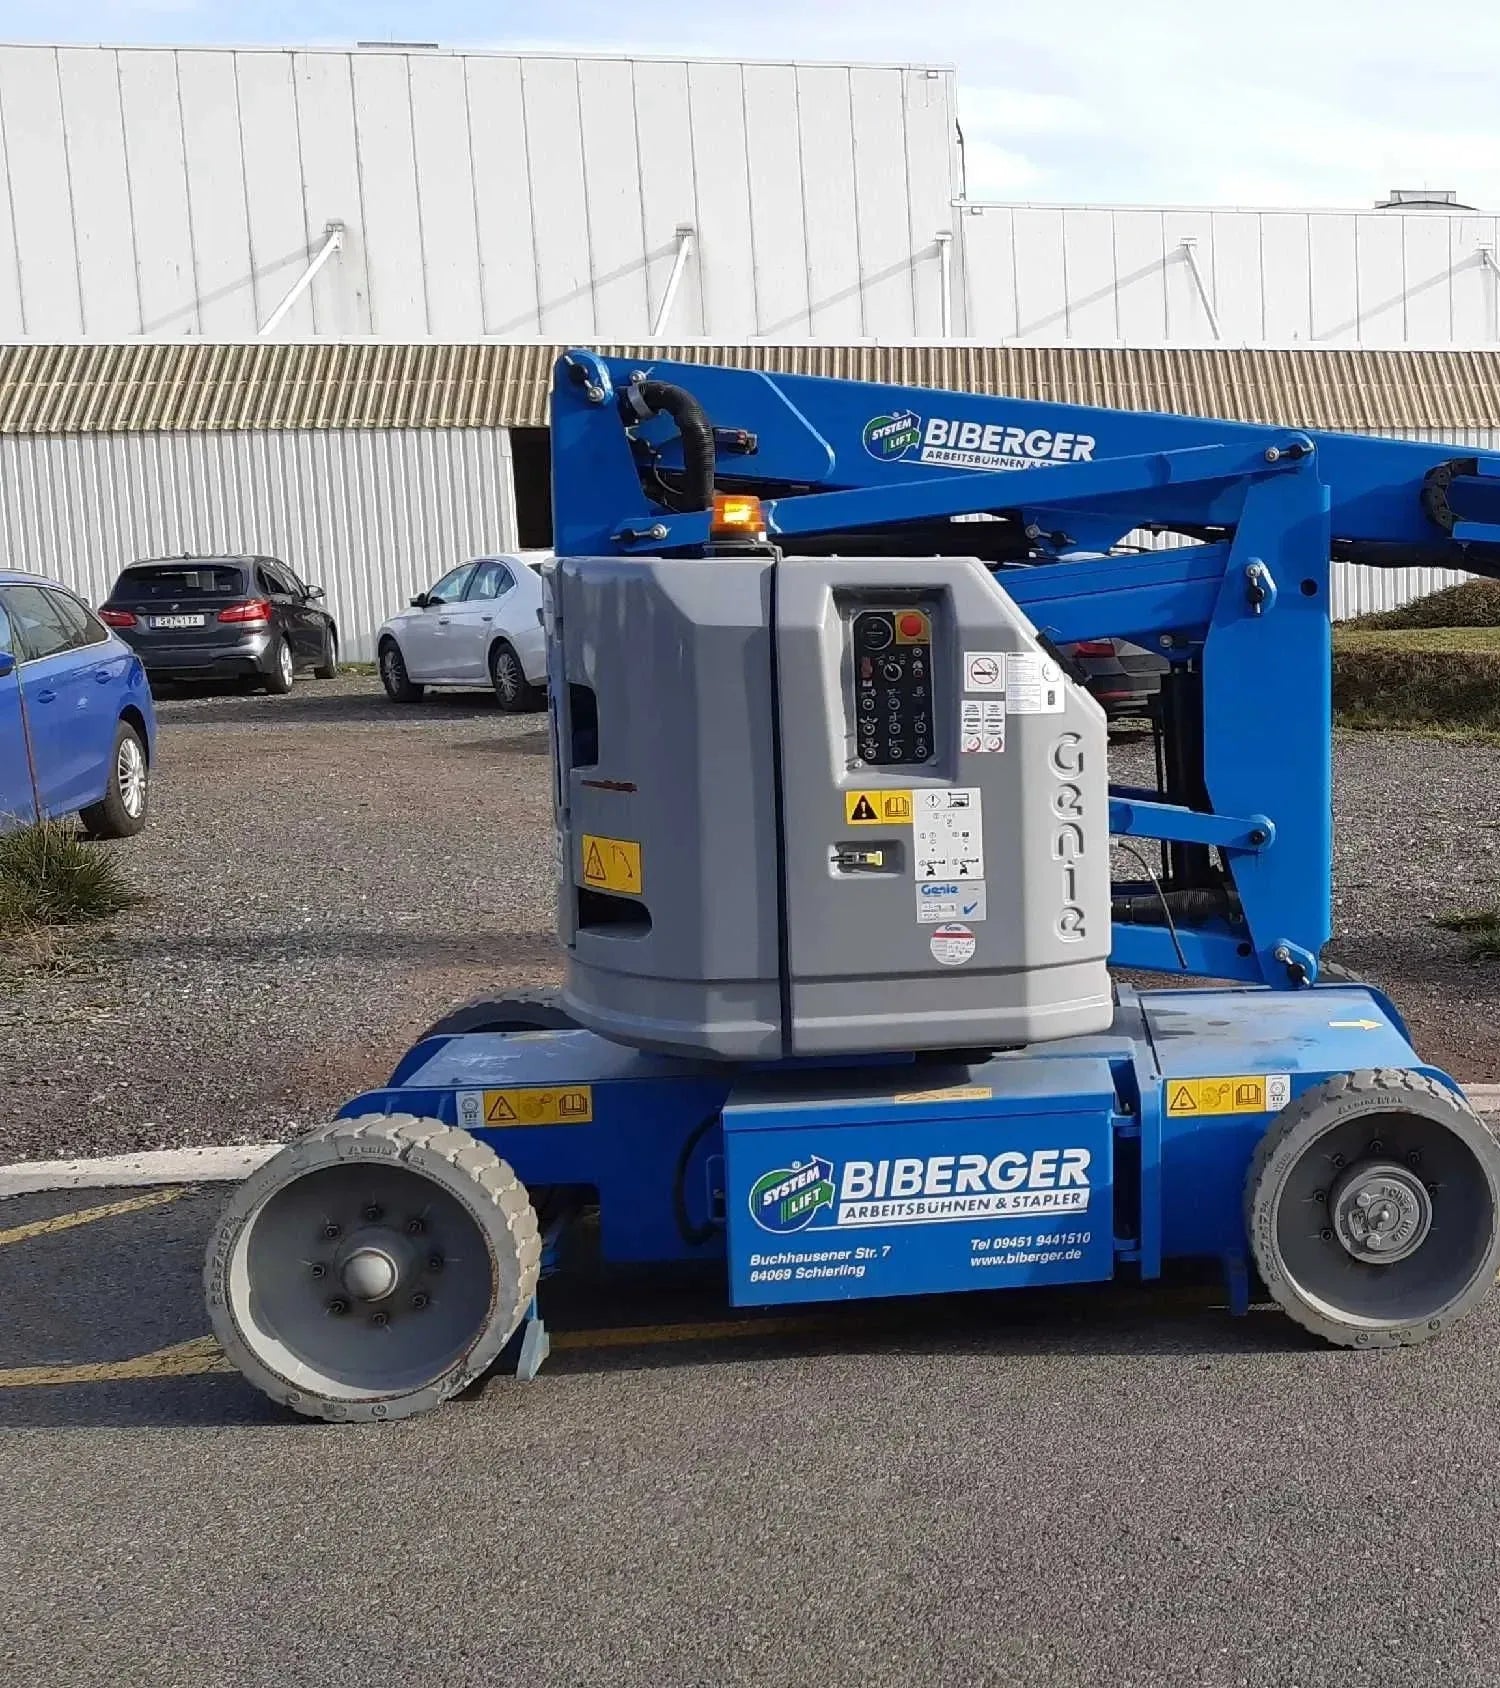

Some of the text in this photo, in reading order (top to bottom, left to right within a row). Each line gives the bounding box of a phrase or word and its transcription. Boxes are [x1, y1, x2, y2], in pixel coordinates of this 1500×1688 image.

[872, 417, 912, 441] SYSTEM
[890, 432, 912, 449] LIFT
[923, 418, 1096, 462] BIBERGER
[1050, 731, 1085, 943] Genie
[921, 883, 960, 895] Genie
[763, 1166, 821, 1206] SYSTEM
[839, 1148, 1091, 1200] BIBERGER
[791, 1188, 822, 1213] LIFT
[845, 1192, 1082, 1219] ARBEITSBÜHNEN & STAPLER
[970, 1232, 1091, 1251] Tel 09451 9441510
[749, 1245, 892, 1266] Buchhausener Str. 7
[970, 1249, 1082, 1267] www.biberger.de
[750, 1264, 866, 1282] 84069 Schierling
